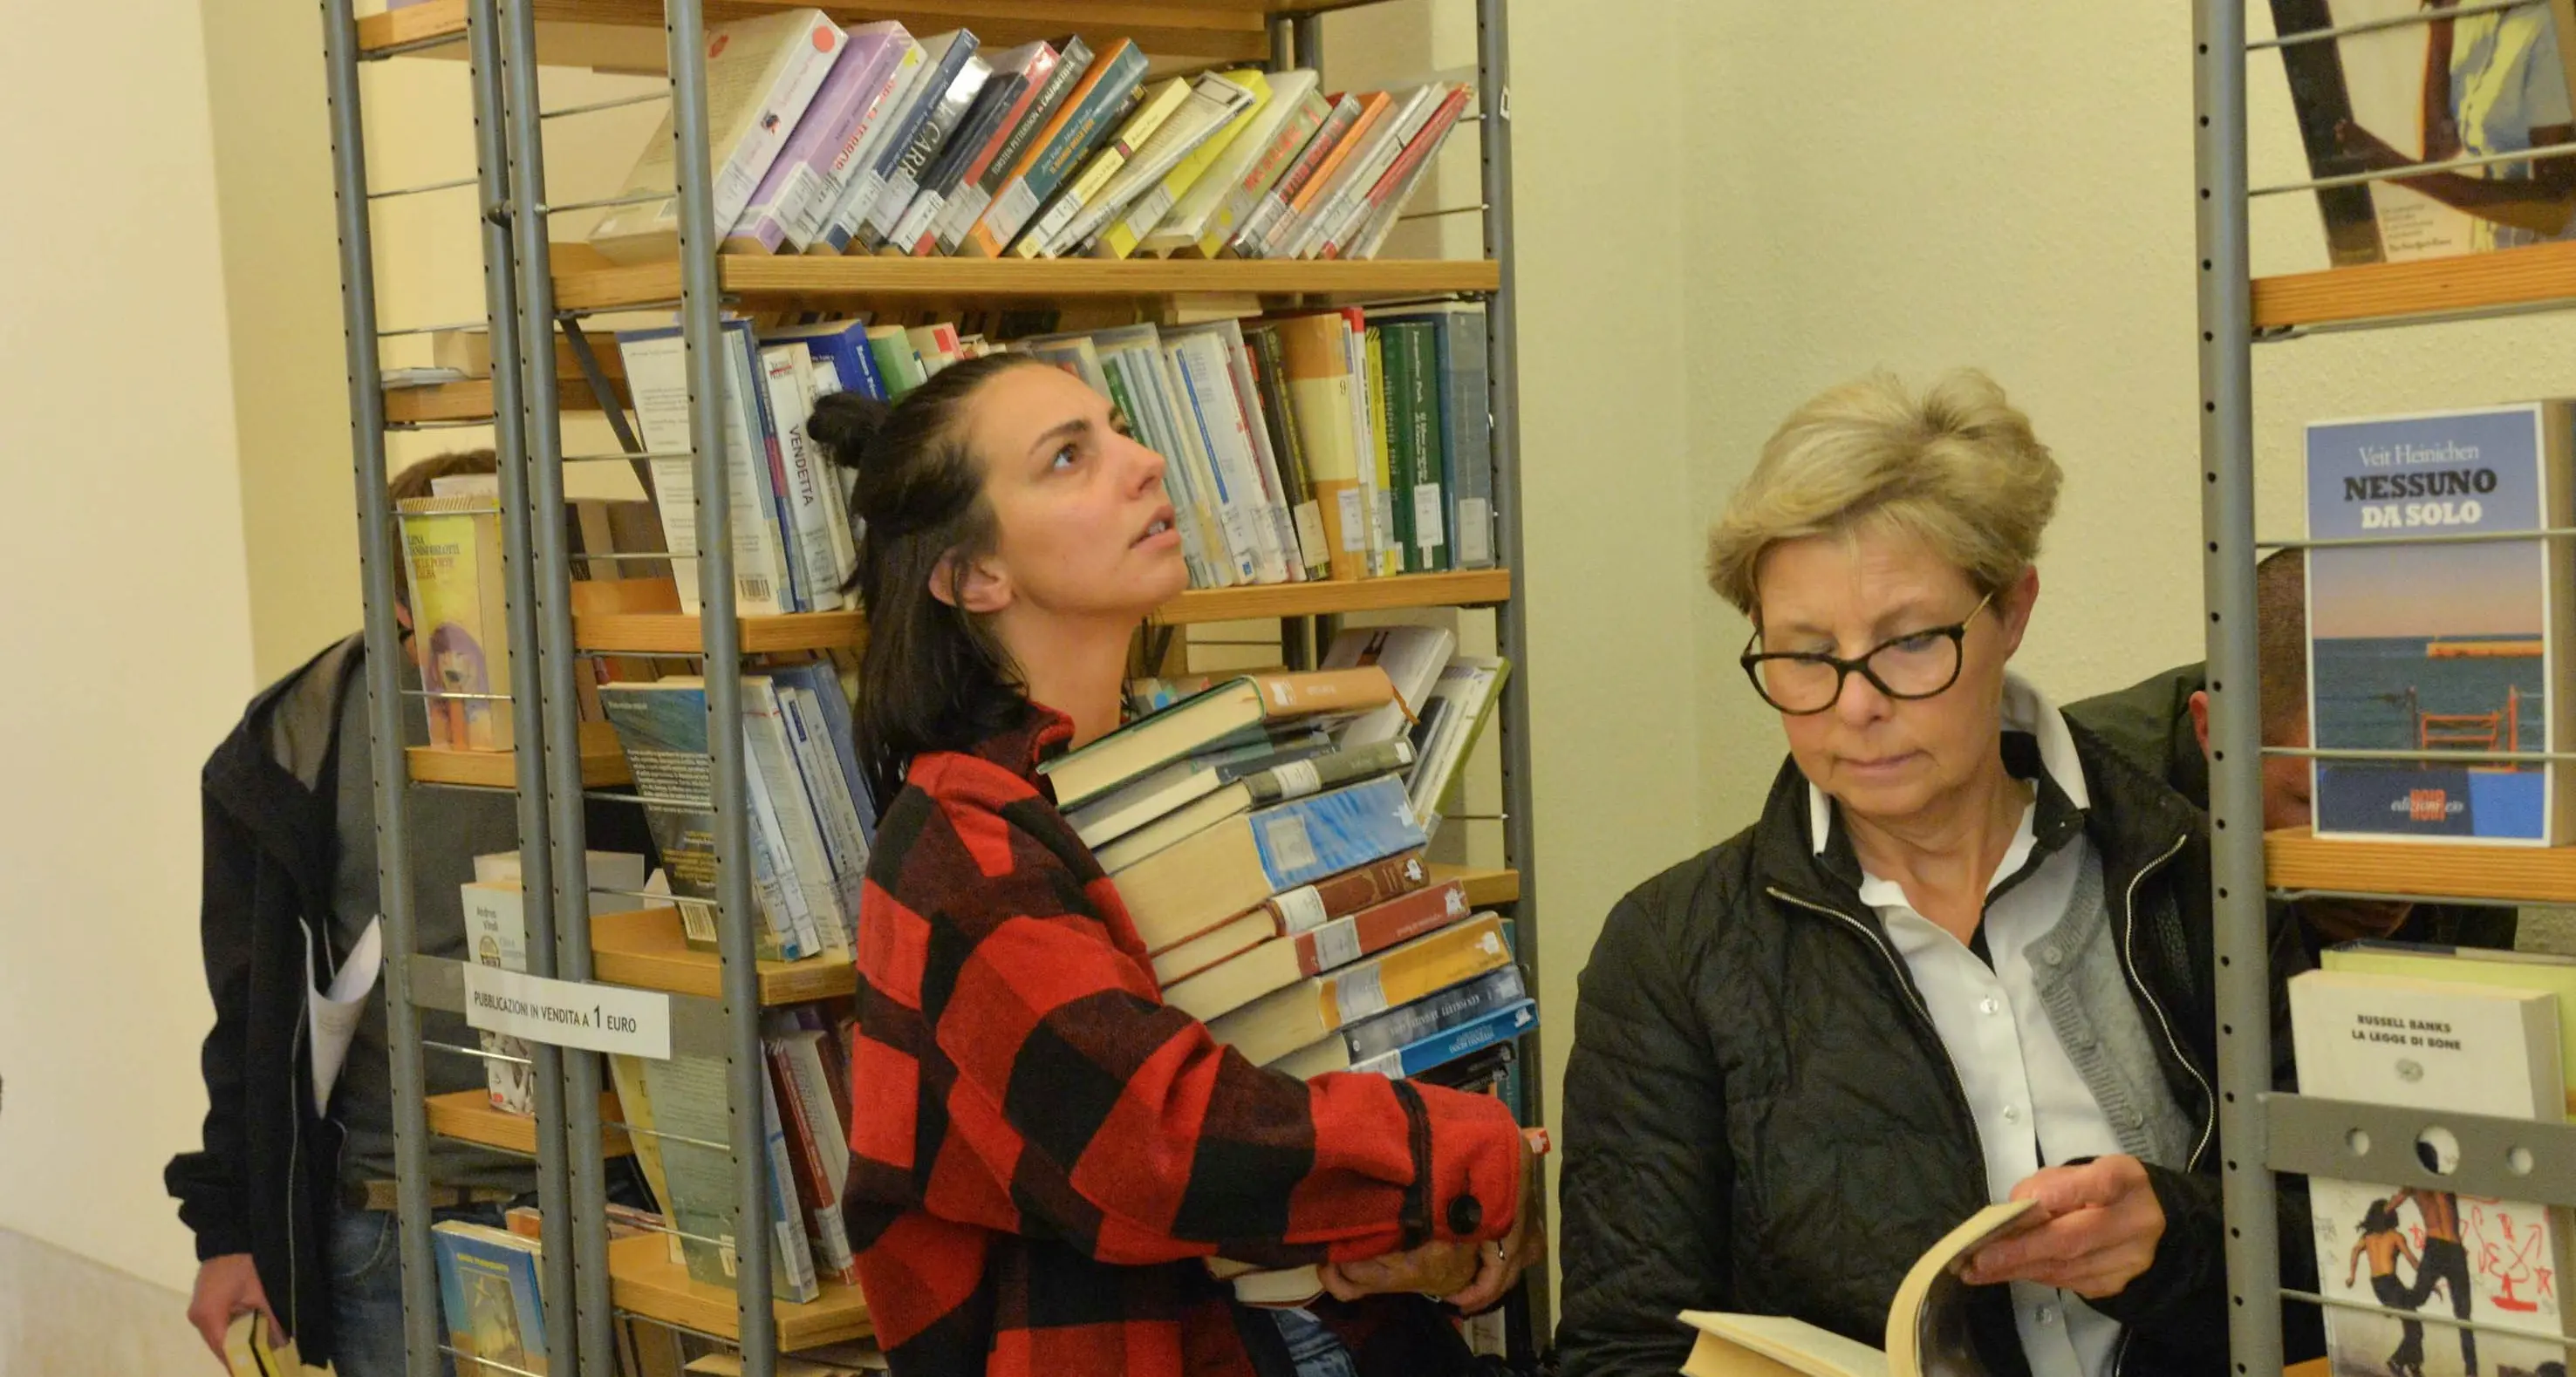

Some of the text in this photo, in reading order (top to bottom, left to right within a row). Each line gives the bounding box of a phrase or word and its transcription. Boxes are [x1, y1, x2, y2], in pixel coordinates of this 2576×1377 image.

[901, 120, 941, 181] CARR
[789, 423, 814, 507] VENDETTA
[2359, 440, 2479, 467] Veit Heinichen
[2343, 467, 2497, 501] NESSUNO
[2361, 500, 2483, 529] DA SOLO
[474, 991, 637, 1033] PUBBLICAZIONI IN VENDITA A 1 EURO
[2357, 1014, 2452, 1033] RUSSELL BANKS
[2351, 1029, 2462, 1051] LA LEGGE DI BONE
